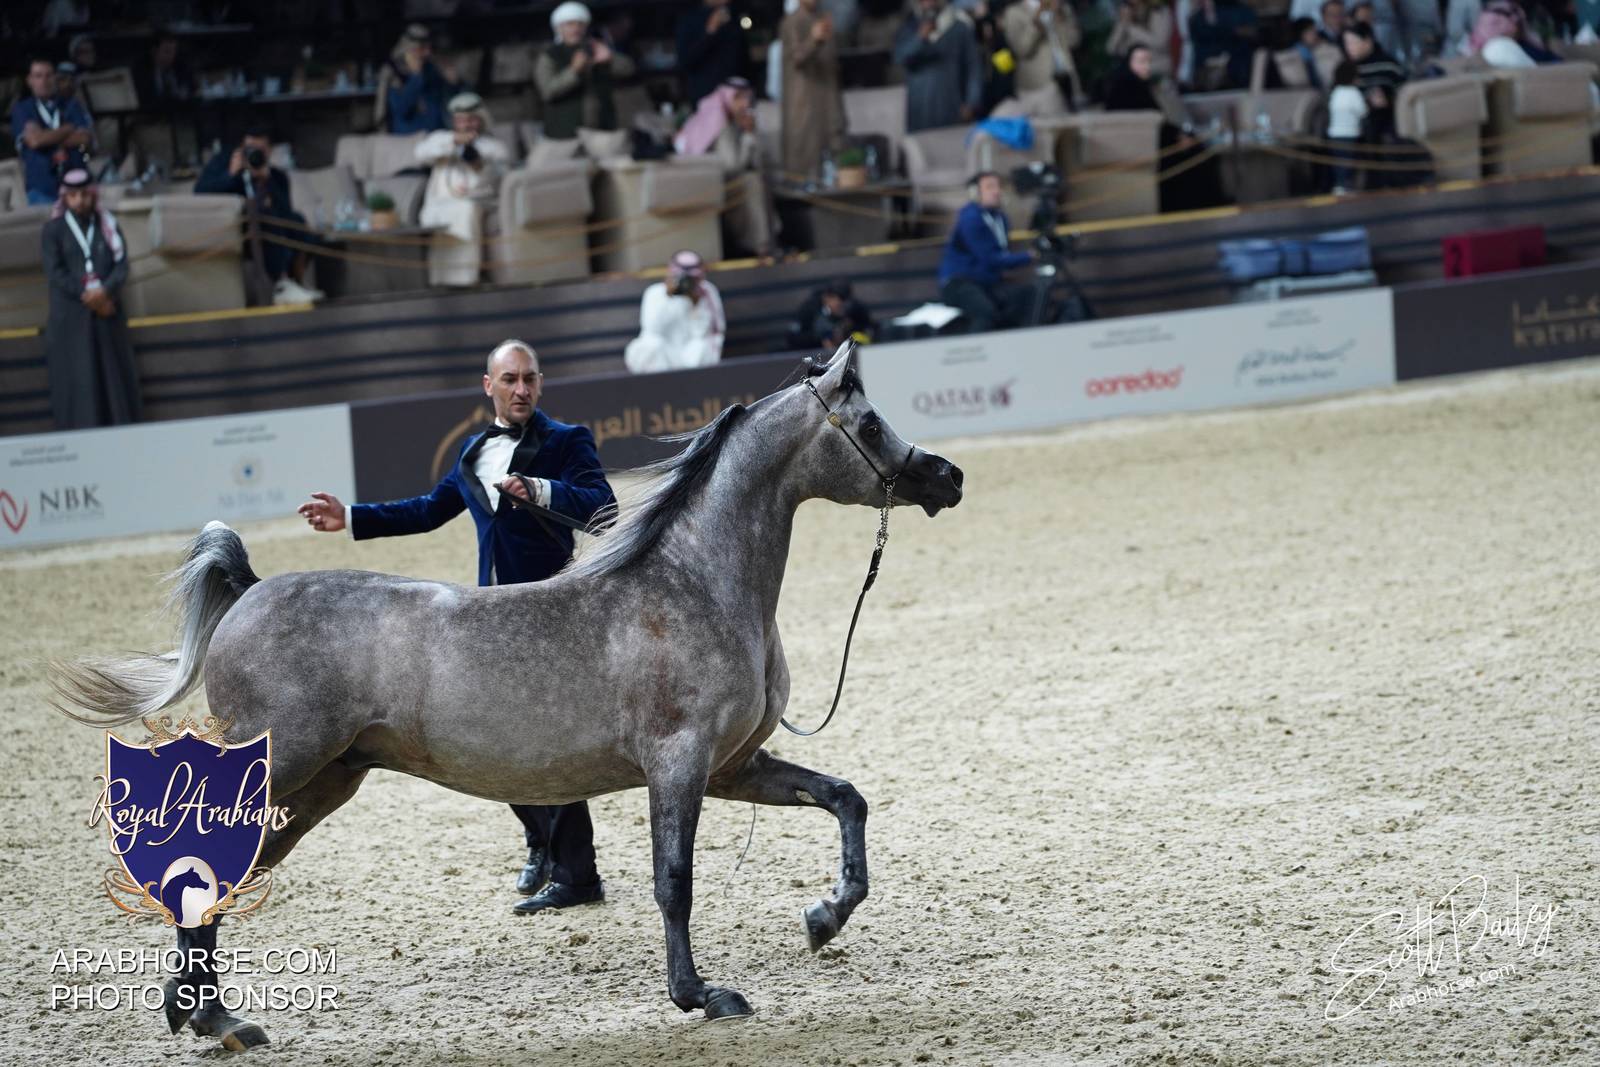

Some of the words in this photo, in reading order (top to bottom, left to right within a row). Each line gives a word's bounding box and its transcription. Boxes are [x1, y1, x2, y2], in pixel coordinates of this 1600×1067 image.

[1084, 364, 1184, 399] ooredoo
[912, 384, 985, 416] QATAR
[39, 484, 103, 514] NBK
